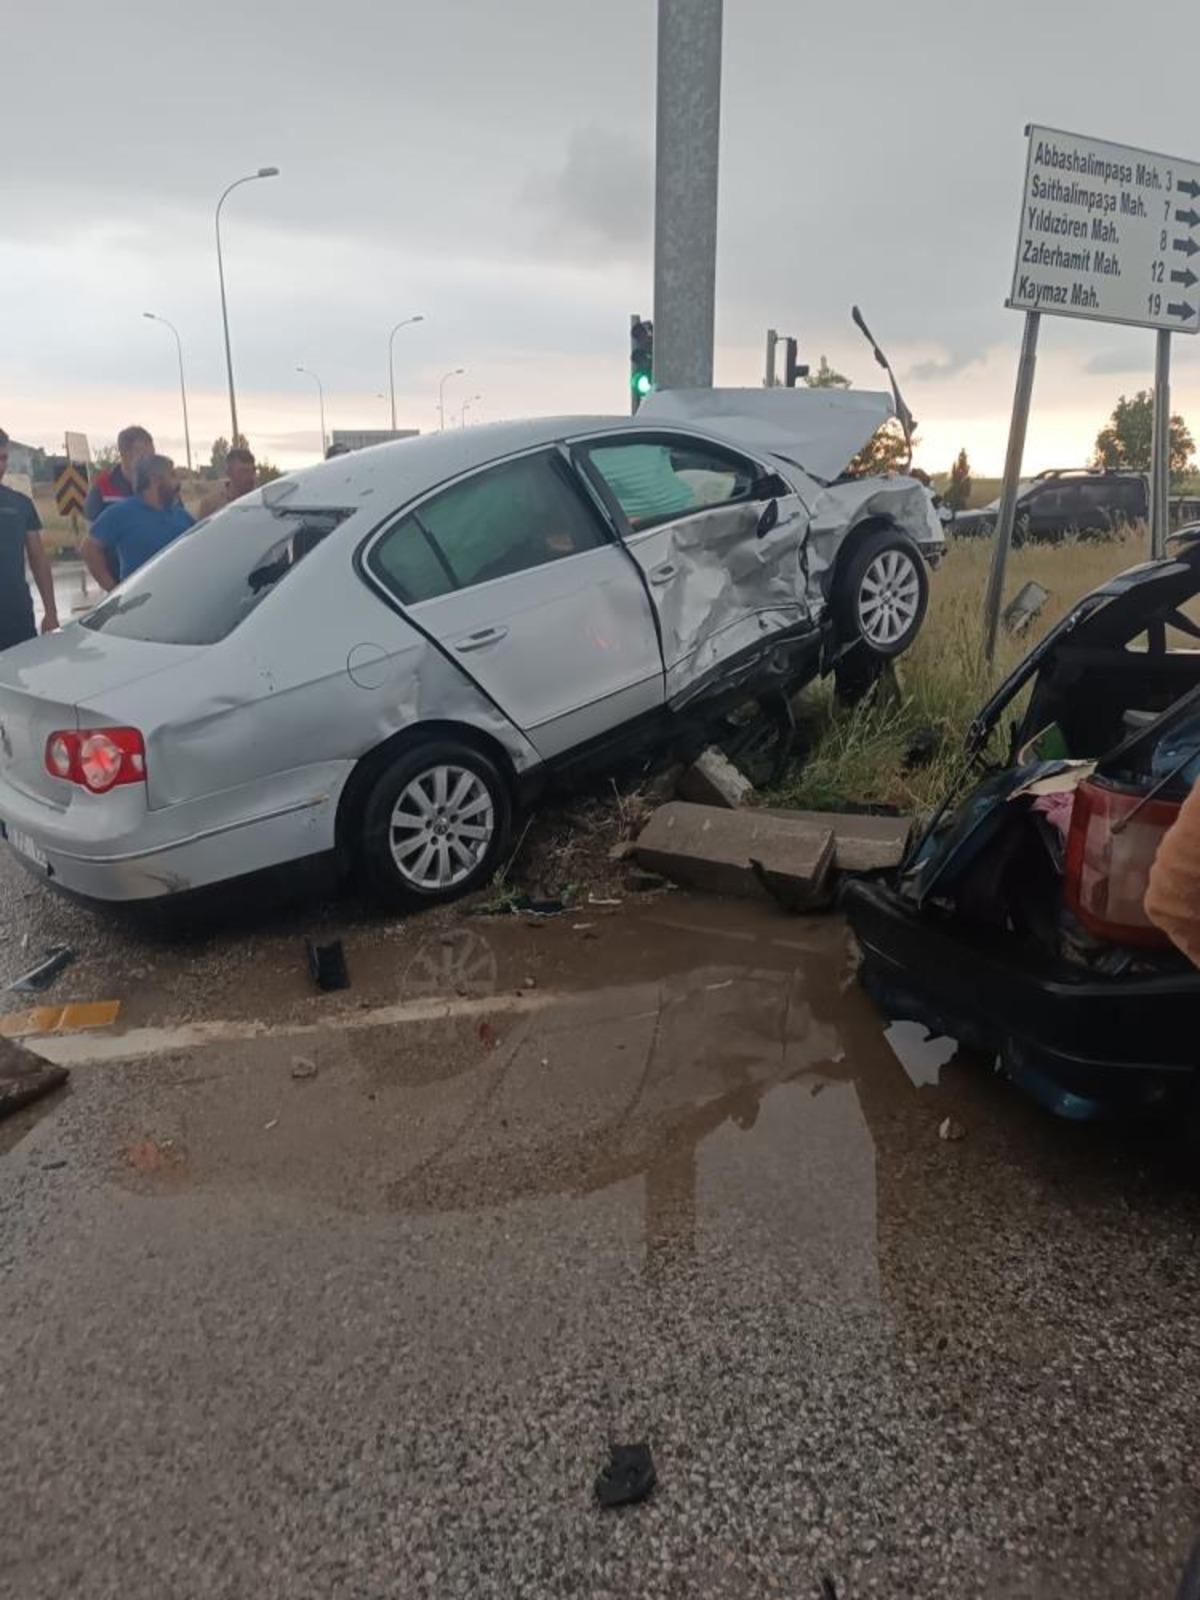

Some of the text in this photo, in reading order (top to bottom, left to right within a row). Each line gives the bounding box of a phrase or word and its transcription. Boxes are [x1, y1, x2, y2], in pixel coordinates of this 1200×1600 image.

[1034, 142, 1173, 192] Abbashalimpaşa Mah. 3
[1031, 174, 1171, 222] Saithalimpaşa Mah. 7
[1028, 207, 1167, 252] Yıldızören Mah. 8
[1022, 239, 1164, 283] Zaferhamit Mah. 12
[1018, 275, 1161, 316] Kaymaz Mah. 19
